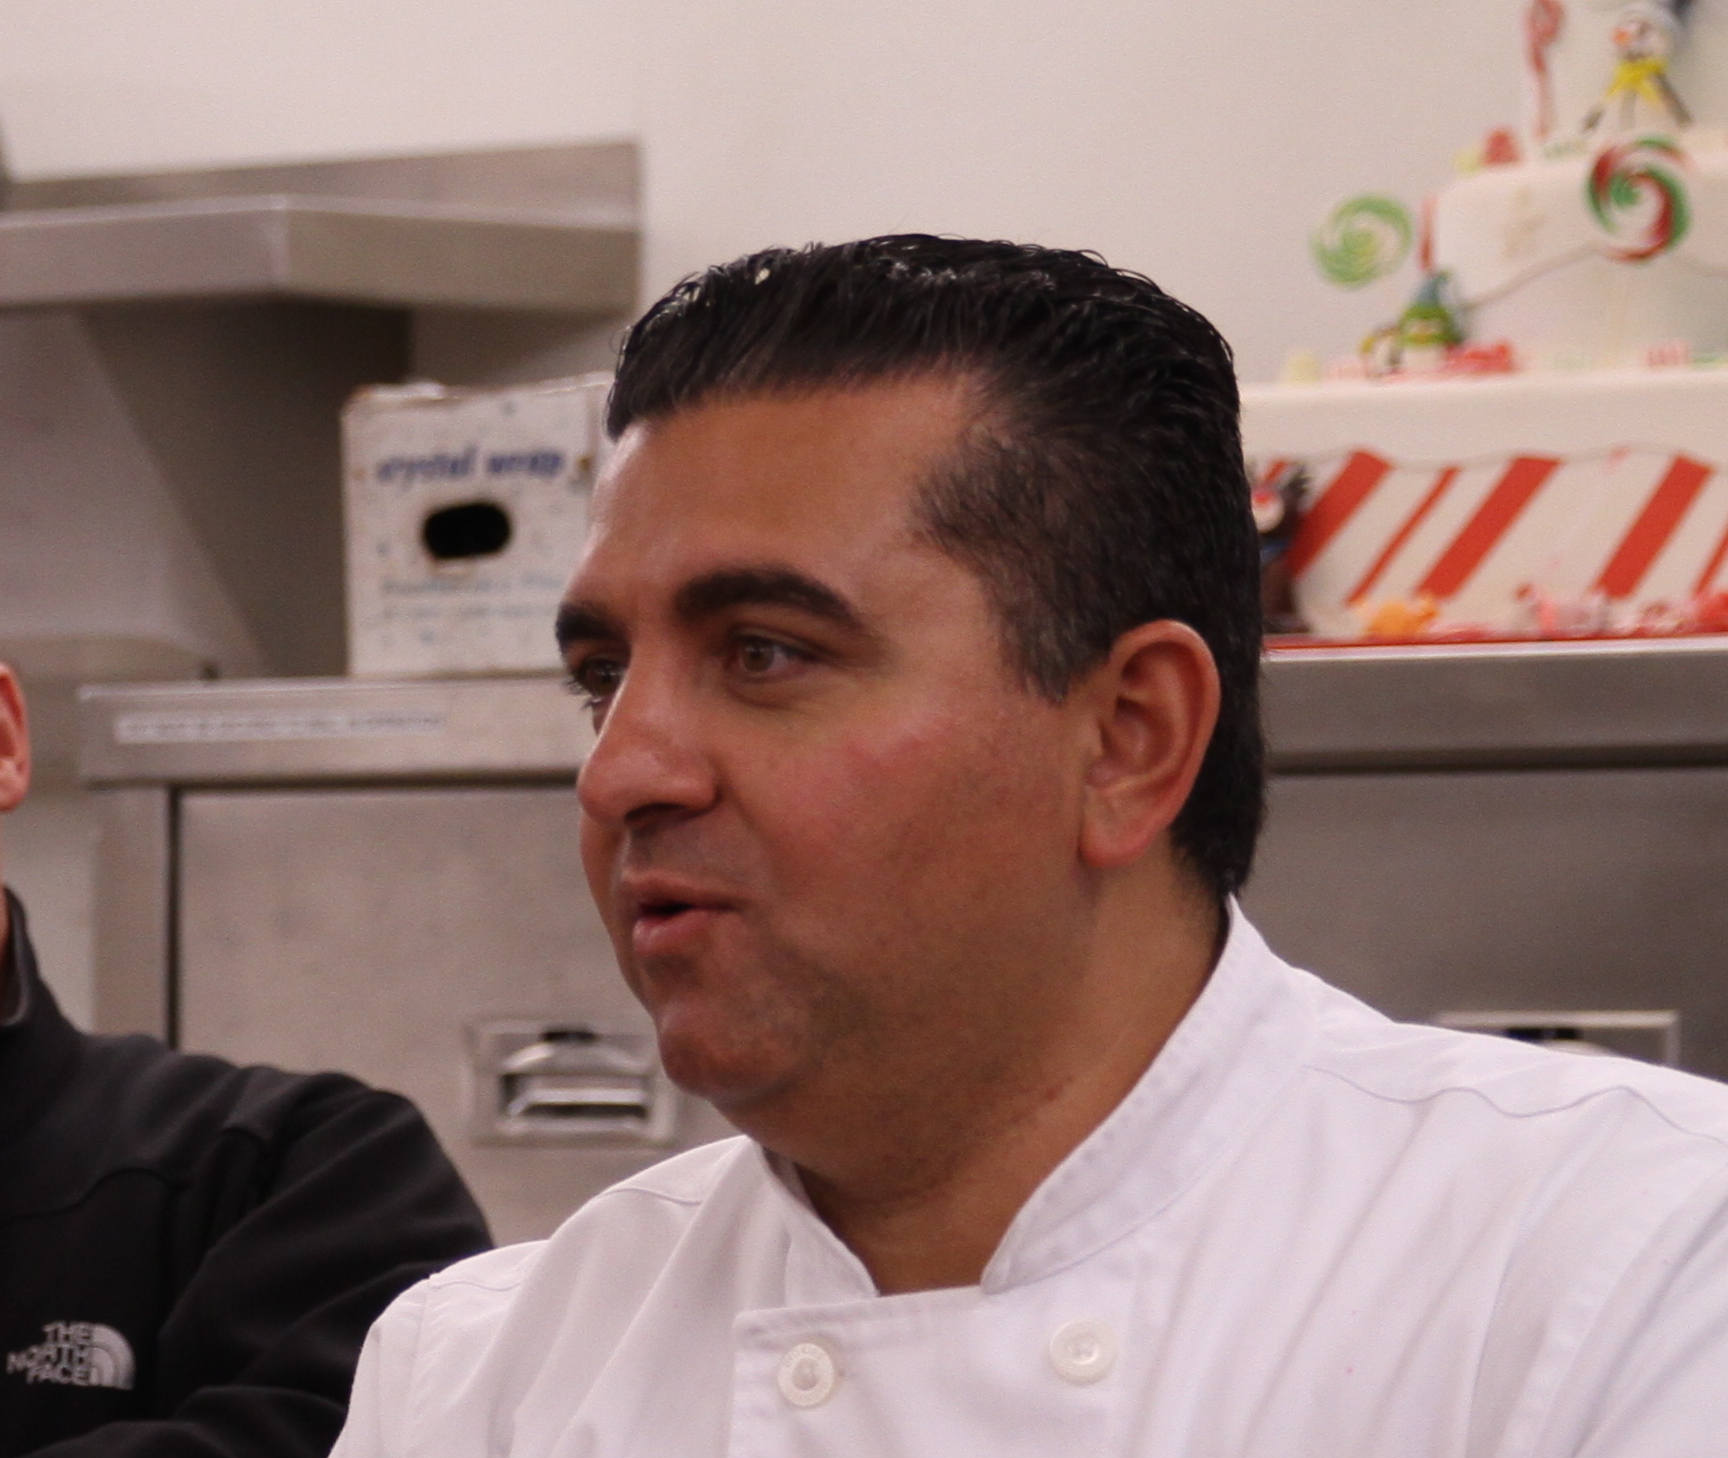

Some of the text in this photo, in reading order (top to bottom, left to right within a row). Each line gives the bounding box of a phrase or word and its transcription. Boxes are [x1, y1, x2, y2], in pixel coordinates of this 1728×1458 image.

[42, 1320, 92, 1342] THE
[6, 1343, 91, 1375] NORTH
[26, 1365, 90, 1387] FACE
